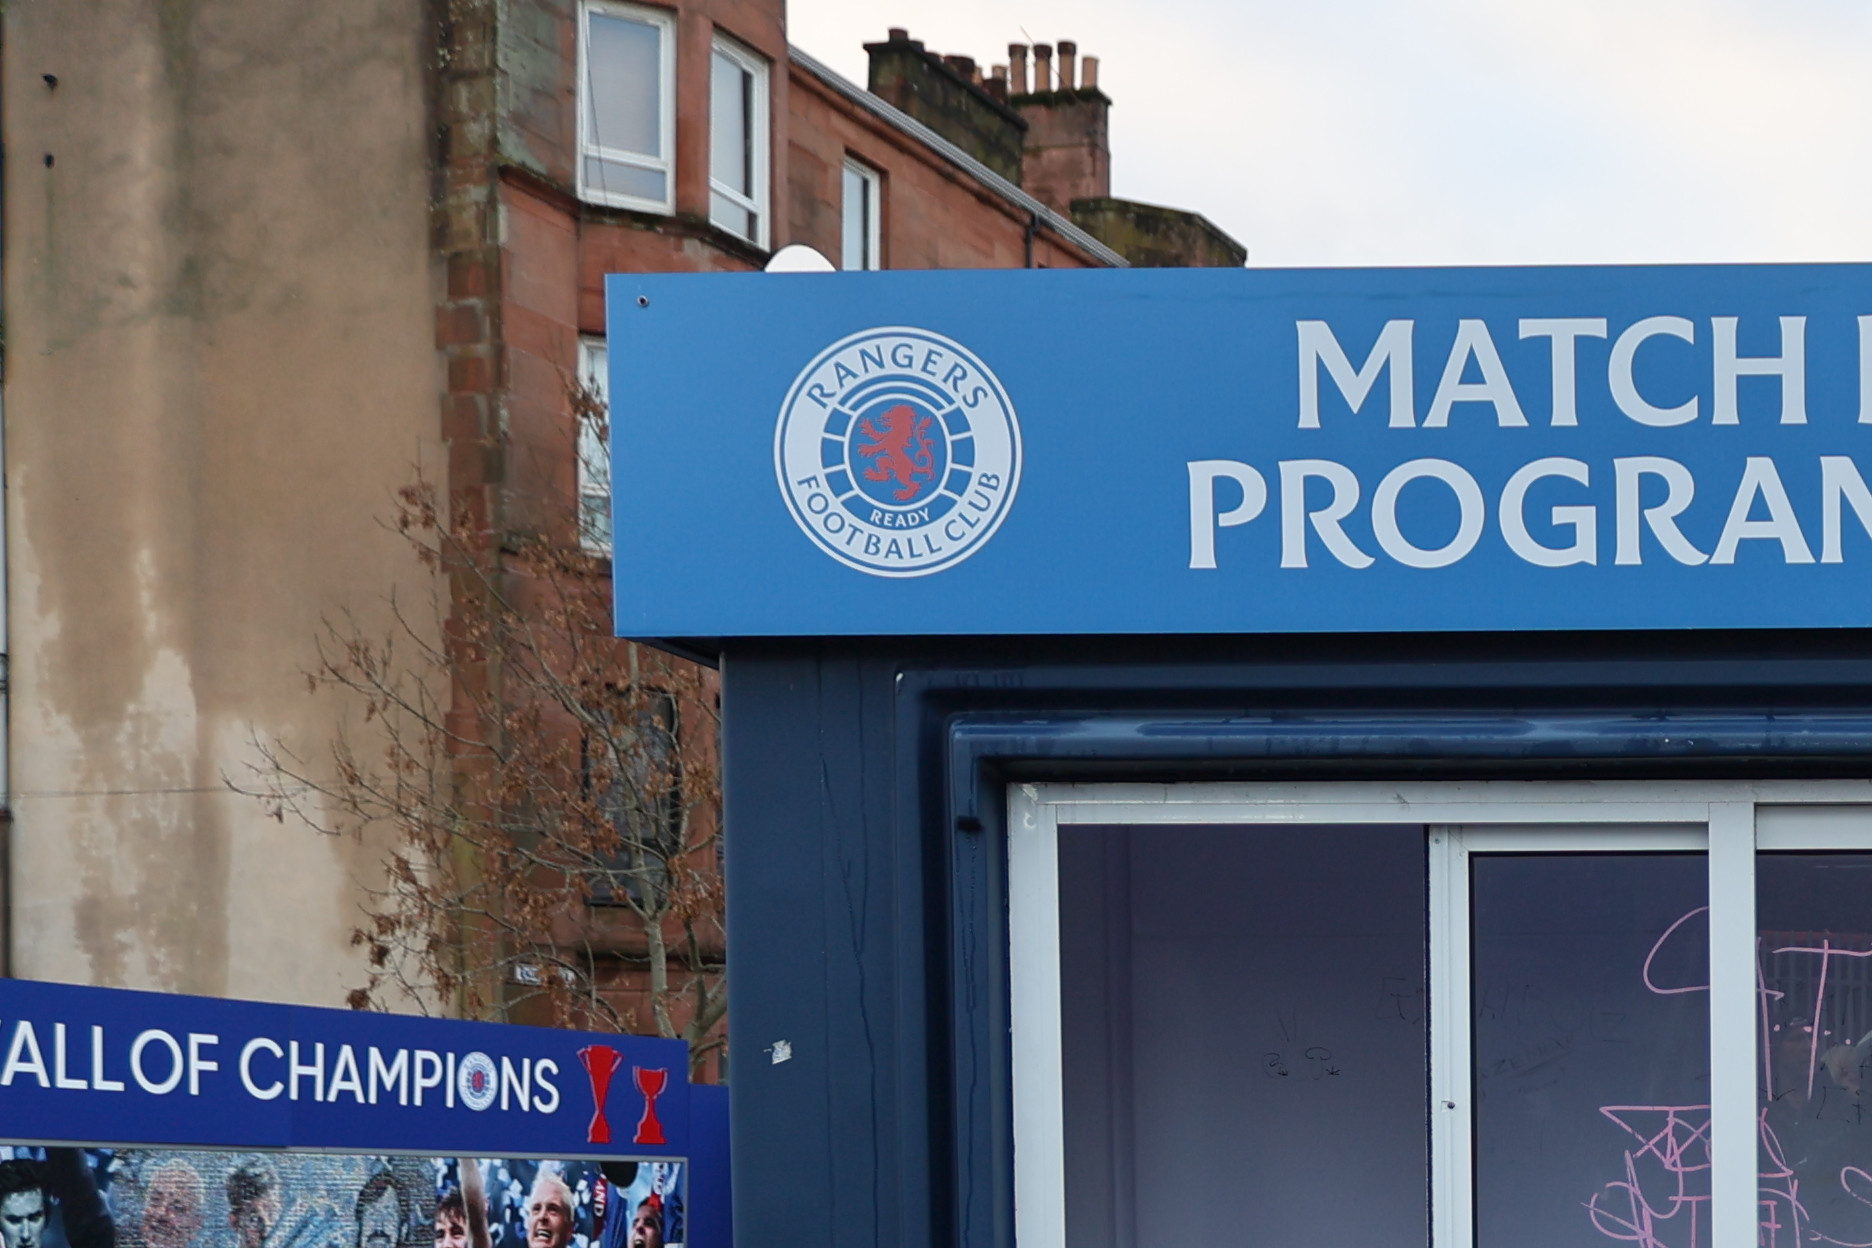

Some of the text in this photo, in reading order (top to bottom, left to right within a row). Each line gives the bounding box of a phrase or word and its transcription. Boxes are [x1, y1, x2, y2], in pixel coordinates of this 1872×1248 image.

[805, 342, 989, 411] RANGERS
[1296, 315, 1808, 428] MATCH
[796, 470, 1003, 562] FOOTBALL CLUB
[870, 507, 932, 529] READY
[0, 1020, 126, 1092] ALL
[130, 1029, 219, 1095] OF
[239, 1037, 560, 1114] CHAMPIONS
